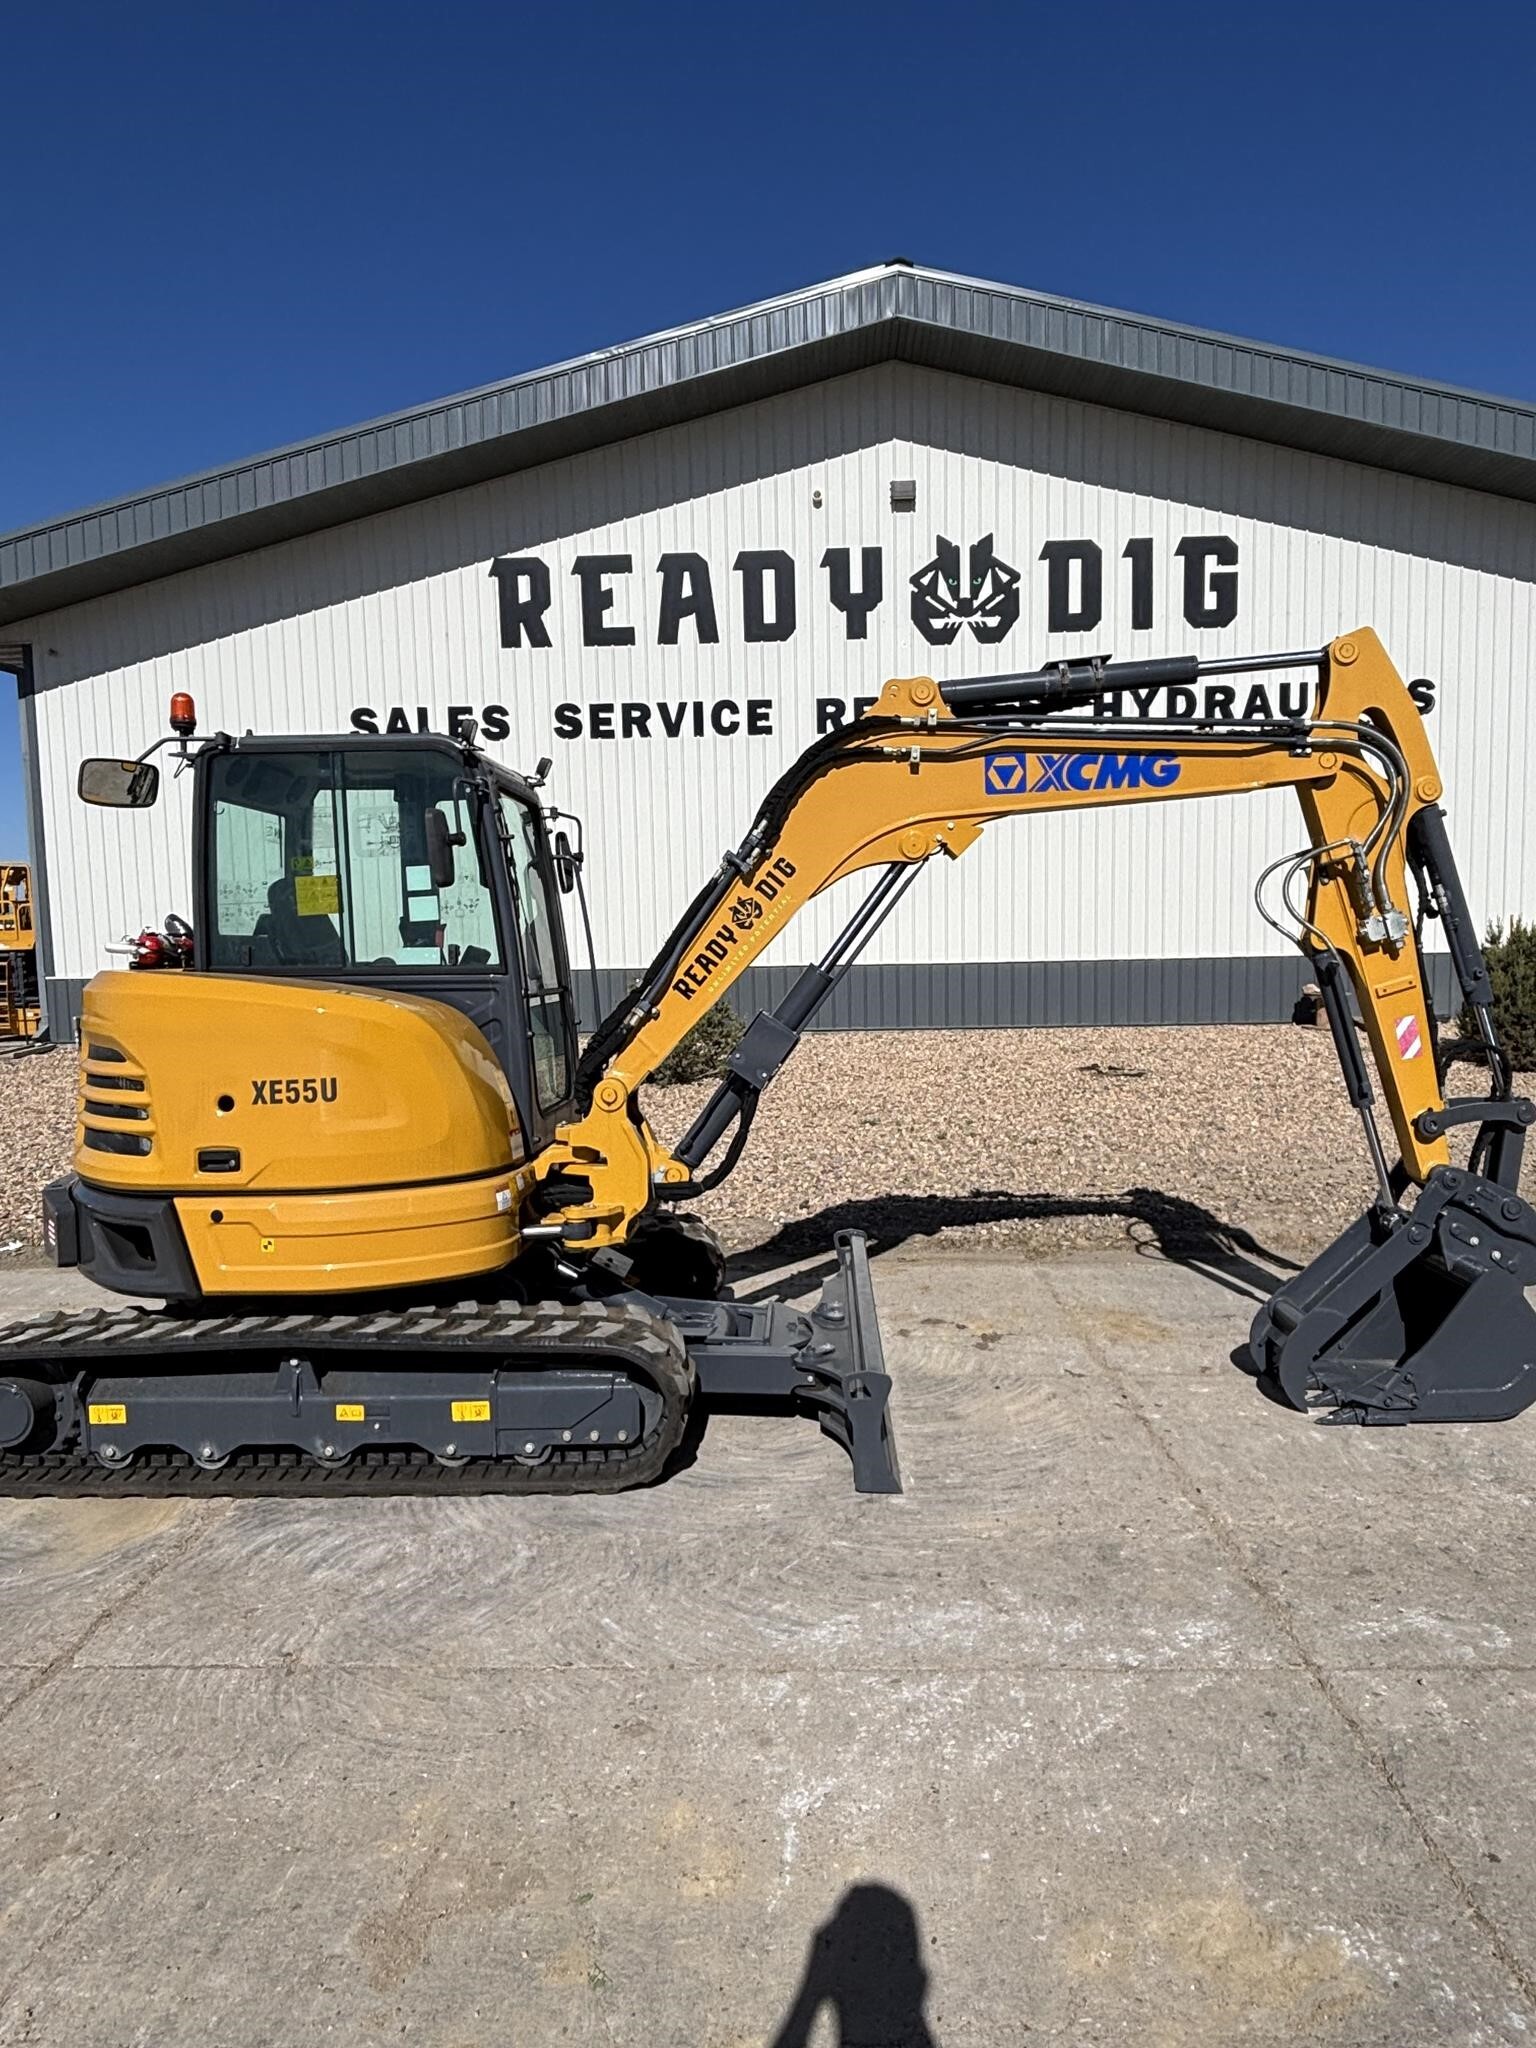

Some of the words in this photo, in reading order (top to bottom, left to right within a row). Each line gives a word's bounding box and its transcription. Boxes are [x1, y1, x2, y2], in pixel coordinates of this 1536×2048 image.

[488, 546, 883, 649] READY
[1039, 535, 1239, 633] DIG
[553, 699, 773, 741] SERVICE
[1093, 678, 1436, 720] HYDRAUS
[1028, 751, 1182, 793] XCMG
[672, 924, 738, 1001] READY
[754, 857, 797, 902] DIG
[707, 944, 749, 993] UNLIMITED
[750, 894, 792, 942] POTENTIAL
[251, 1077, 338, 1105] XE55U
